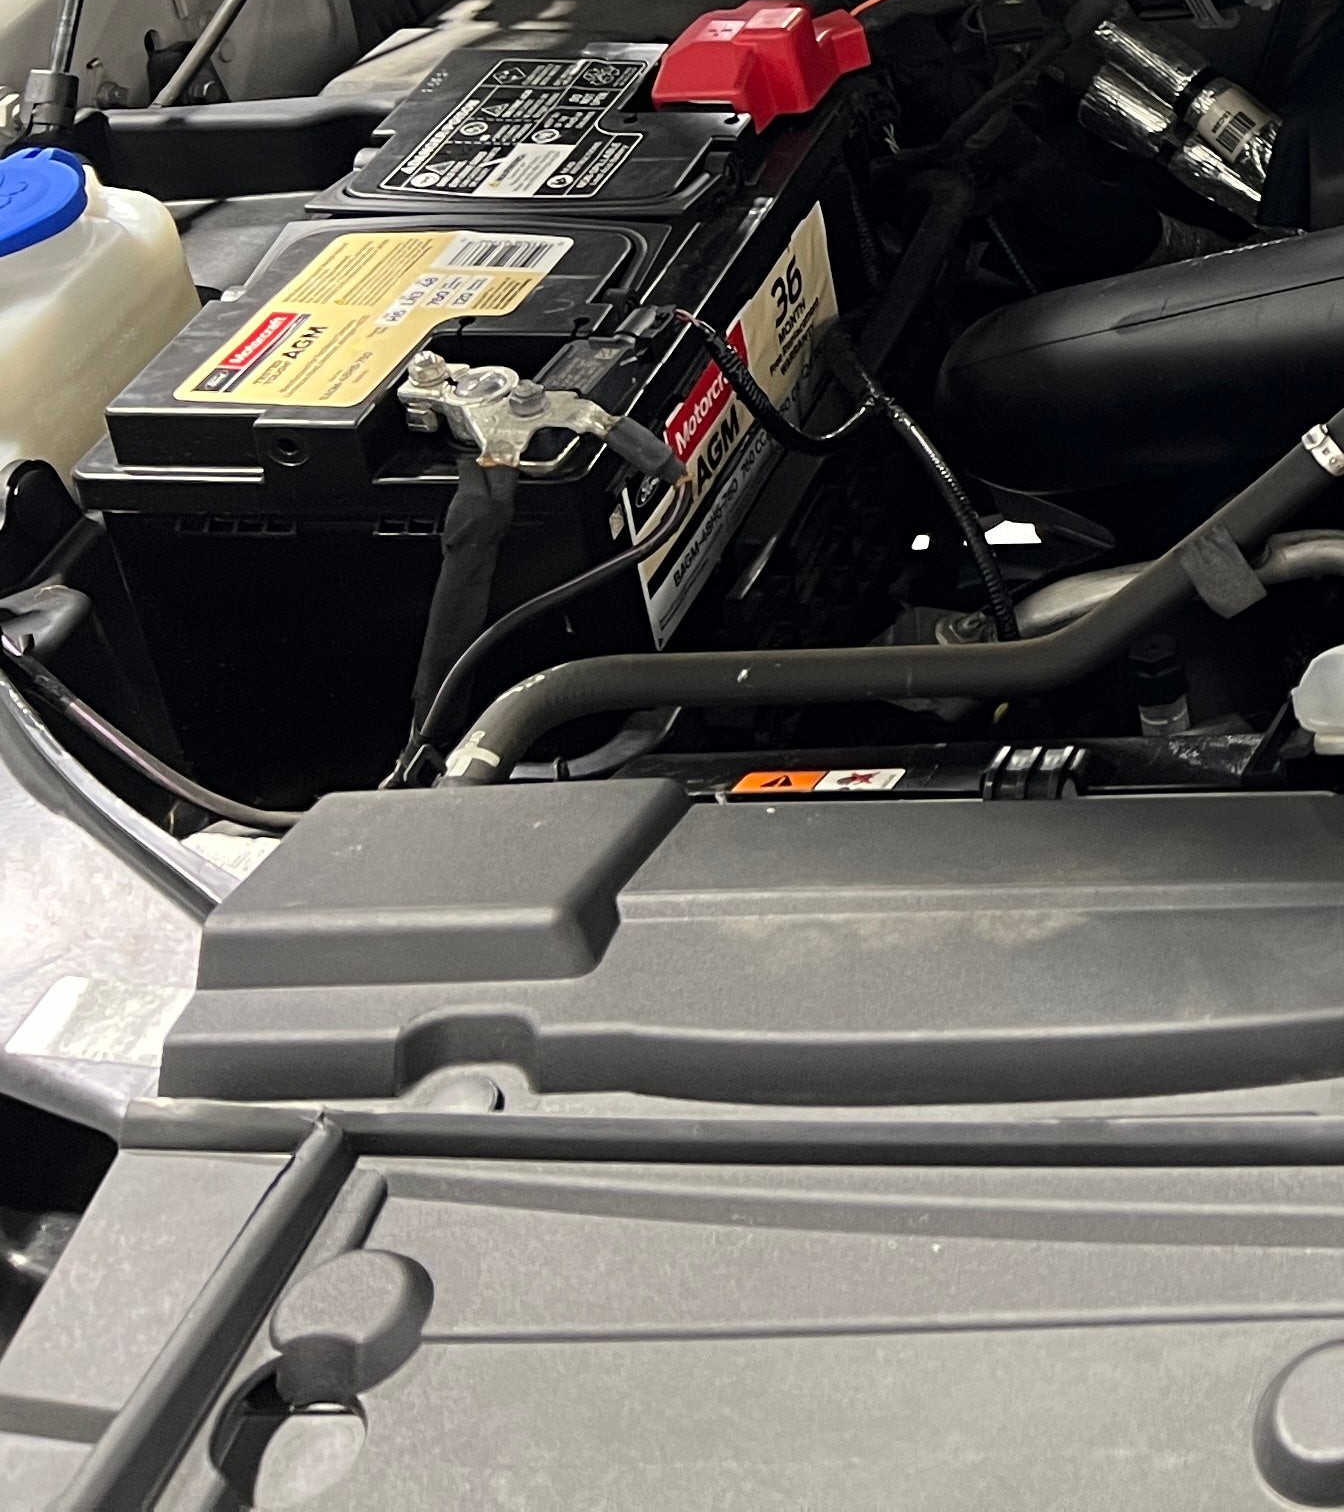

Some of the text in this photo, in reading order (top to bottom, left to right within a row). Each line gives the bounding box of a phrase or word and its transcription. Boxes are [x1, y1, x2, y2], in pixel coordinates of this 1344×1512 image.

[769, 257, 802, 329] 36
[778, 299, 806, 345] MONTH
[229, 316, 289, 364] Motorcraft
[282, 326, 328, 359] AGM
[675, 371, 732, 455] Motorcr
[694, 403, 740, 495] AGM
